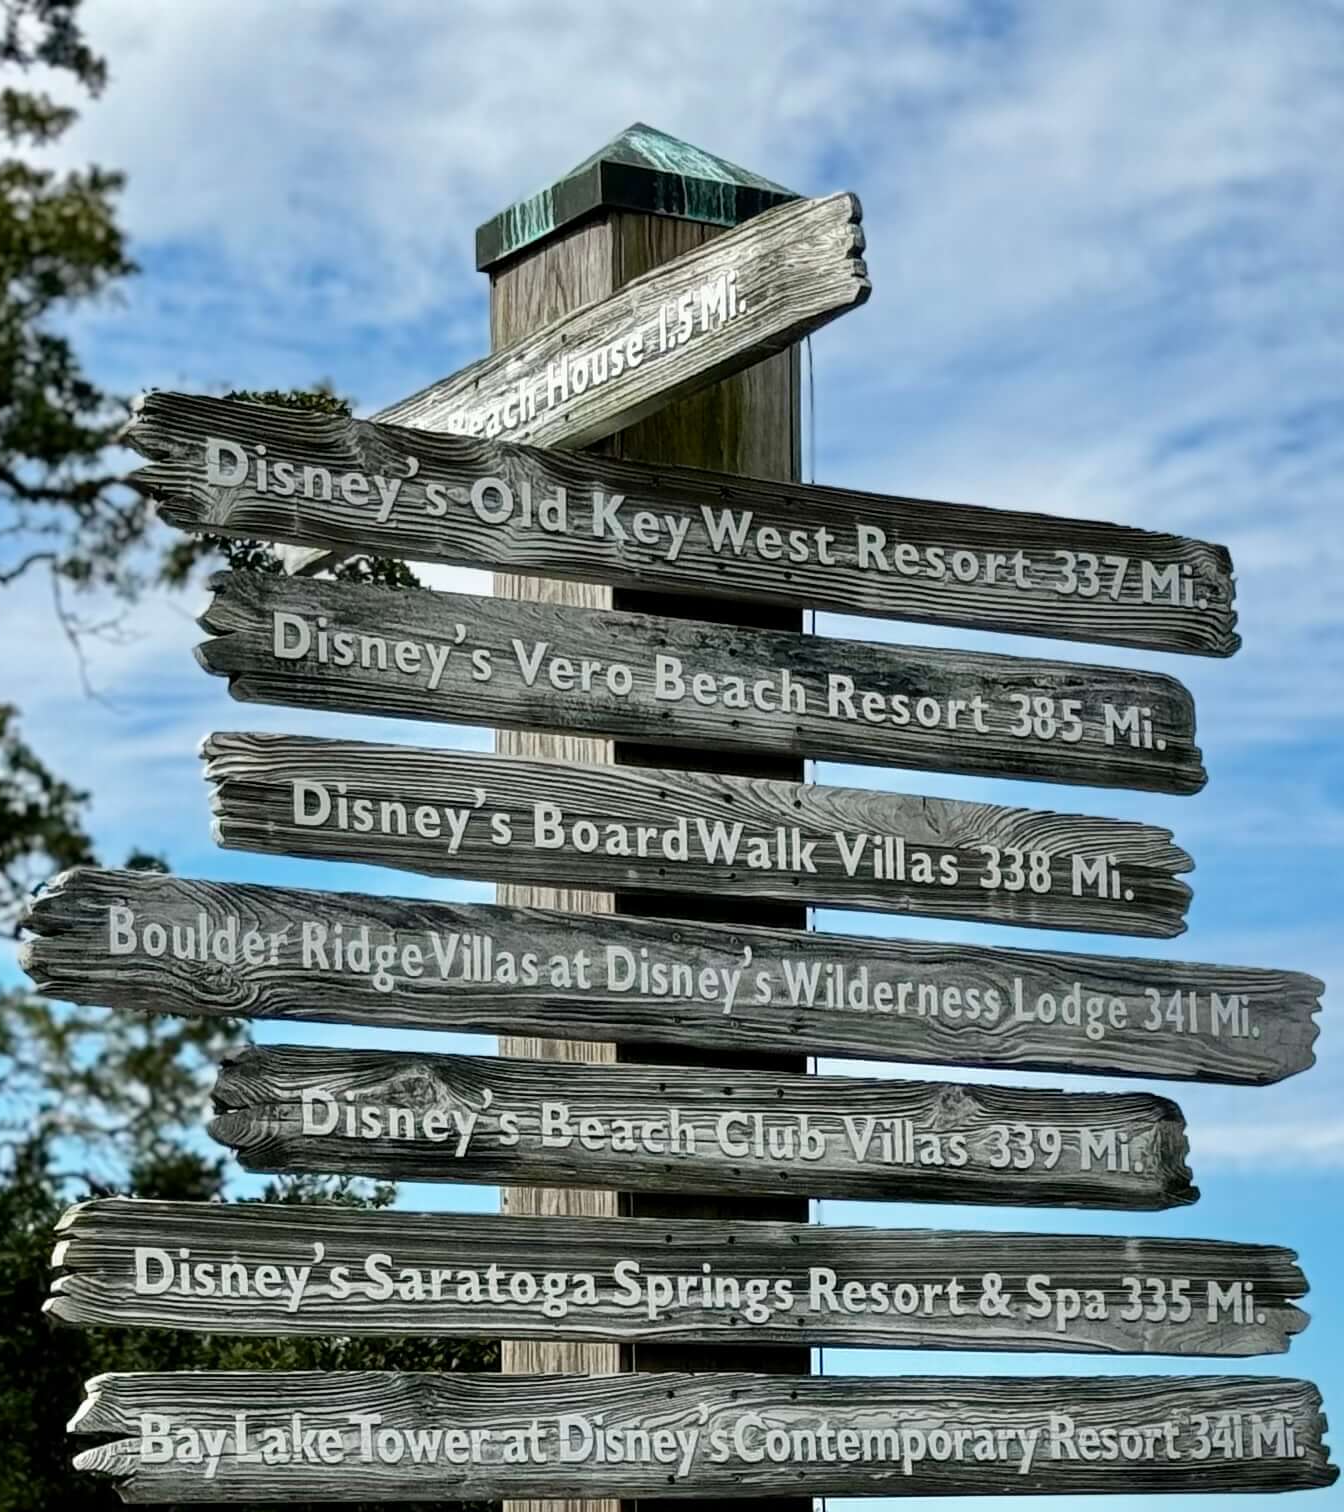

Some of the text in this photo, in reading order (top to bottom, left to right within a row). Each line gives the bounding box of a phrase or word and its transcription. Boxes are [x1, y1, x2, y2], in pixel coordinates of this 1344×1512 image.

[547, 332, 644, 409] House
[659, 298, 695, 352] 1.5
[699, 269, 747, 330] Mi.
[206, 437, 1209, 610] Disney's Old Key West Resort 337 Mi.
[273, 611, 1167, 752] Disney's Vero Beach Resort 385 Mi.
[293, 779, 1134, 901] Disney's BoardWalk Villas 338 Mi.
[109, 905, 1260, 1041] Boulder Ridge Villas at Disney's Wilderness Lodge 341 Mi.
[301, 1087, 1145, 1173] Disney's Beach Club Villas 339 Mi.
[134, 1242, 1267, 1332] Disney's Saratoga Springs Resort & Spa 335 Mi.
[140, 1404, 1306, 1479] Bay Lake Tower at Disney's Contemporary Resort 341 Mi.
